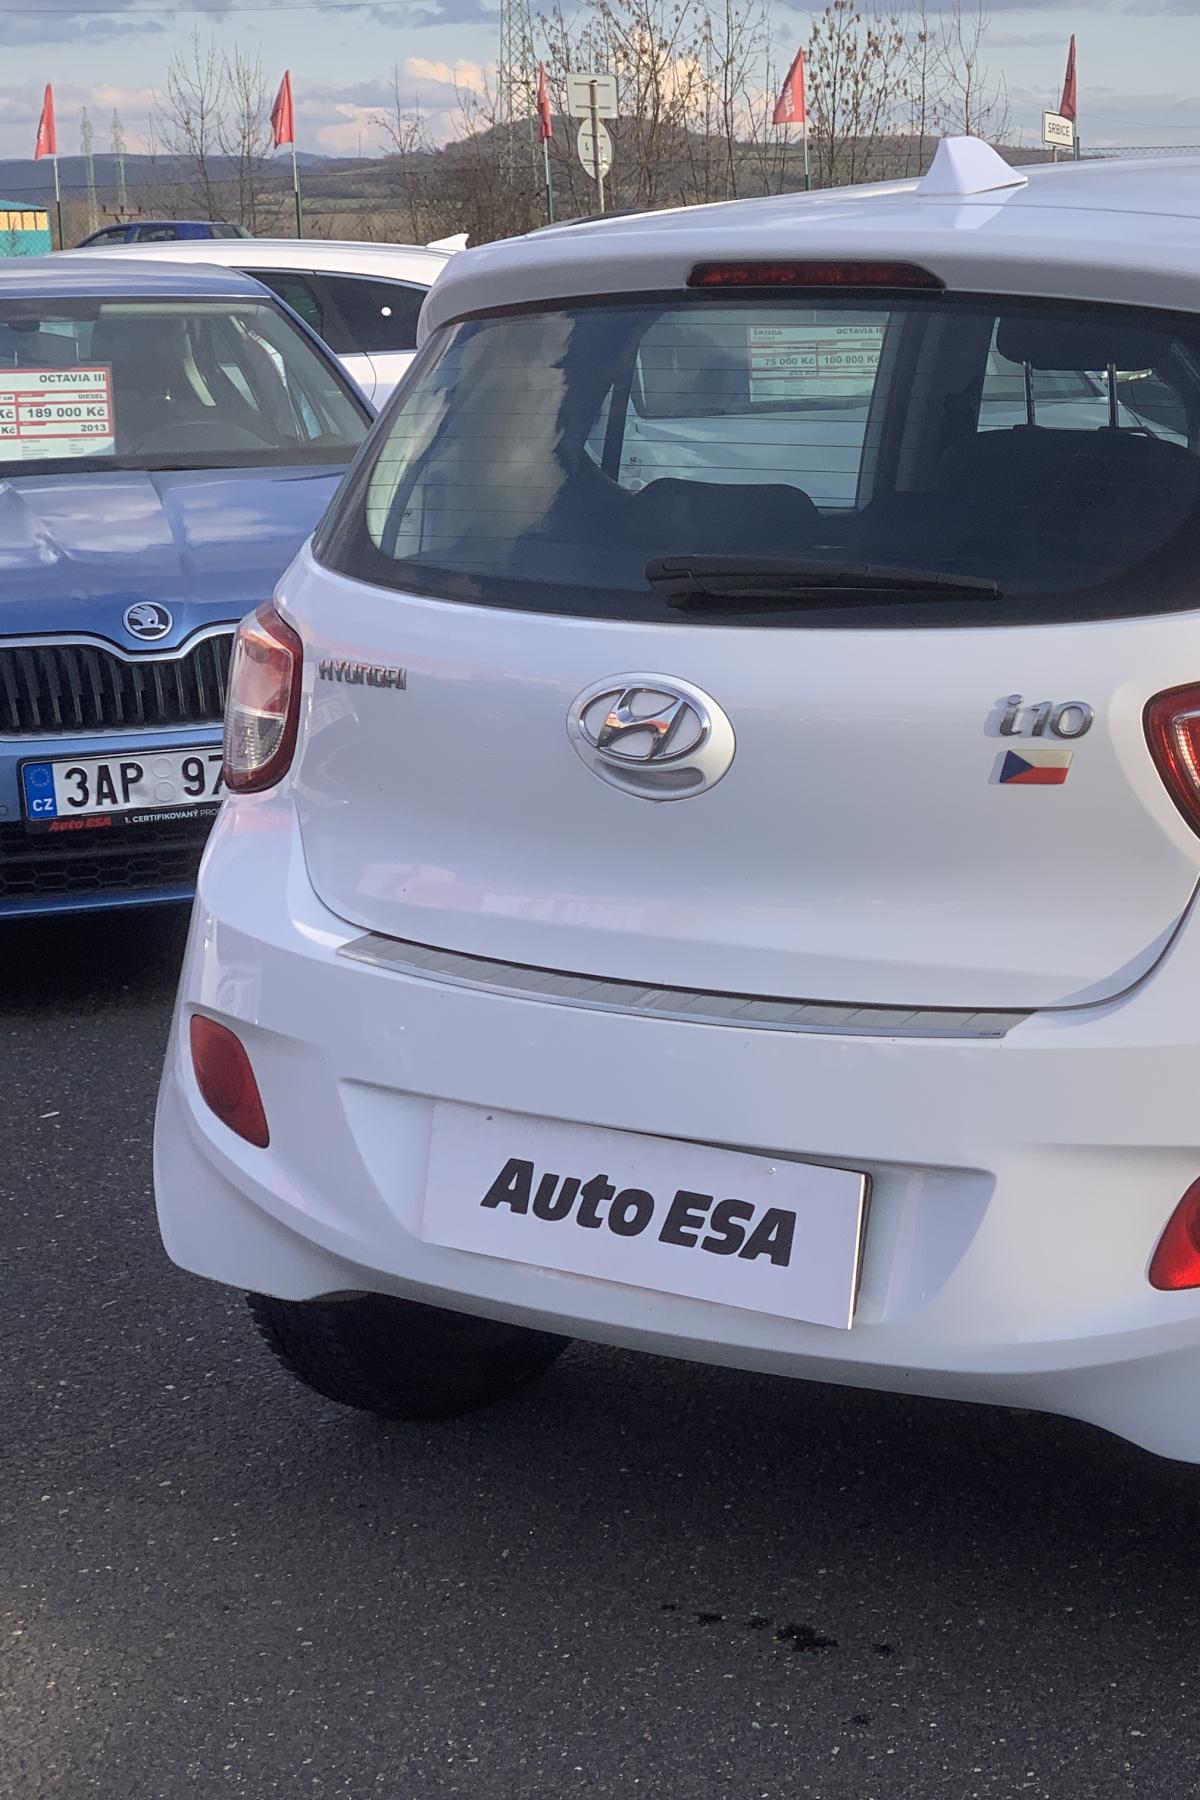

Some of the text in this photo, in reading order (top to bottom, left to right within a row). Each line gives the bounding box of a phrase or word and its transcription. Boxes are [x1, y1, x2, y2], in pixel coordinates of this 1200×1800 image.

[1048, 122, 1070, 137] SRBICE
[836, 327, 873, 335] OCTAVIA
[779, 357, 798, 366] 000
[845, 354, 864, 364] 000
[39, 373, 105, 383] OCTAVIA III
[27, 405, 105, 418] 189 000 Kč
[1, 426, 15, 435] Kč
[81, 424, 106, 433] 2013
[319, 659, 407, 691] HYUNDAI
[999, 693, 1095, 739] i10
[64, 761, 144, 808] 3AP
[32, 798, 54, 813] CZ
[48, 816, 112, 832] Auto ESA
[133, 809, 198, 824] CERTIFIKOVANÝ
[480, 1158, 797, 1267] Auto ESA
